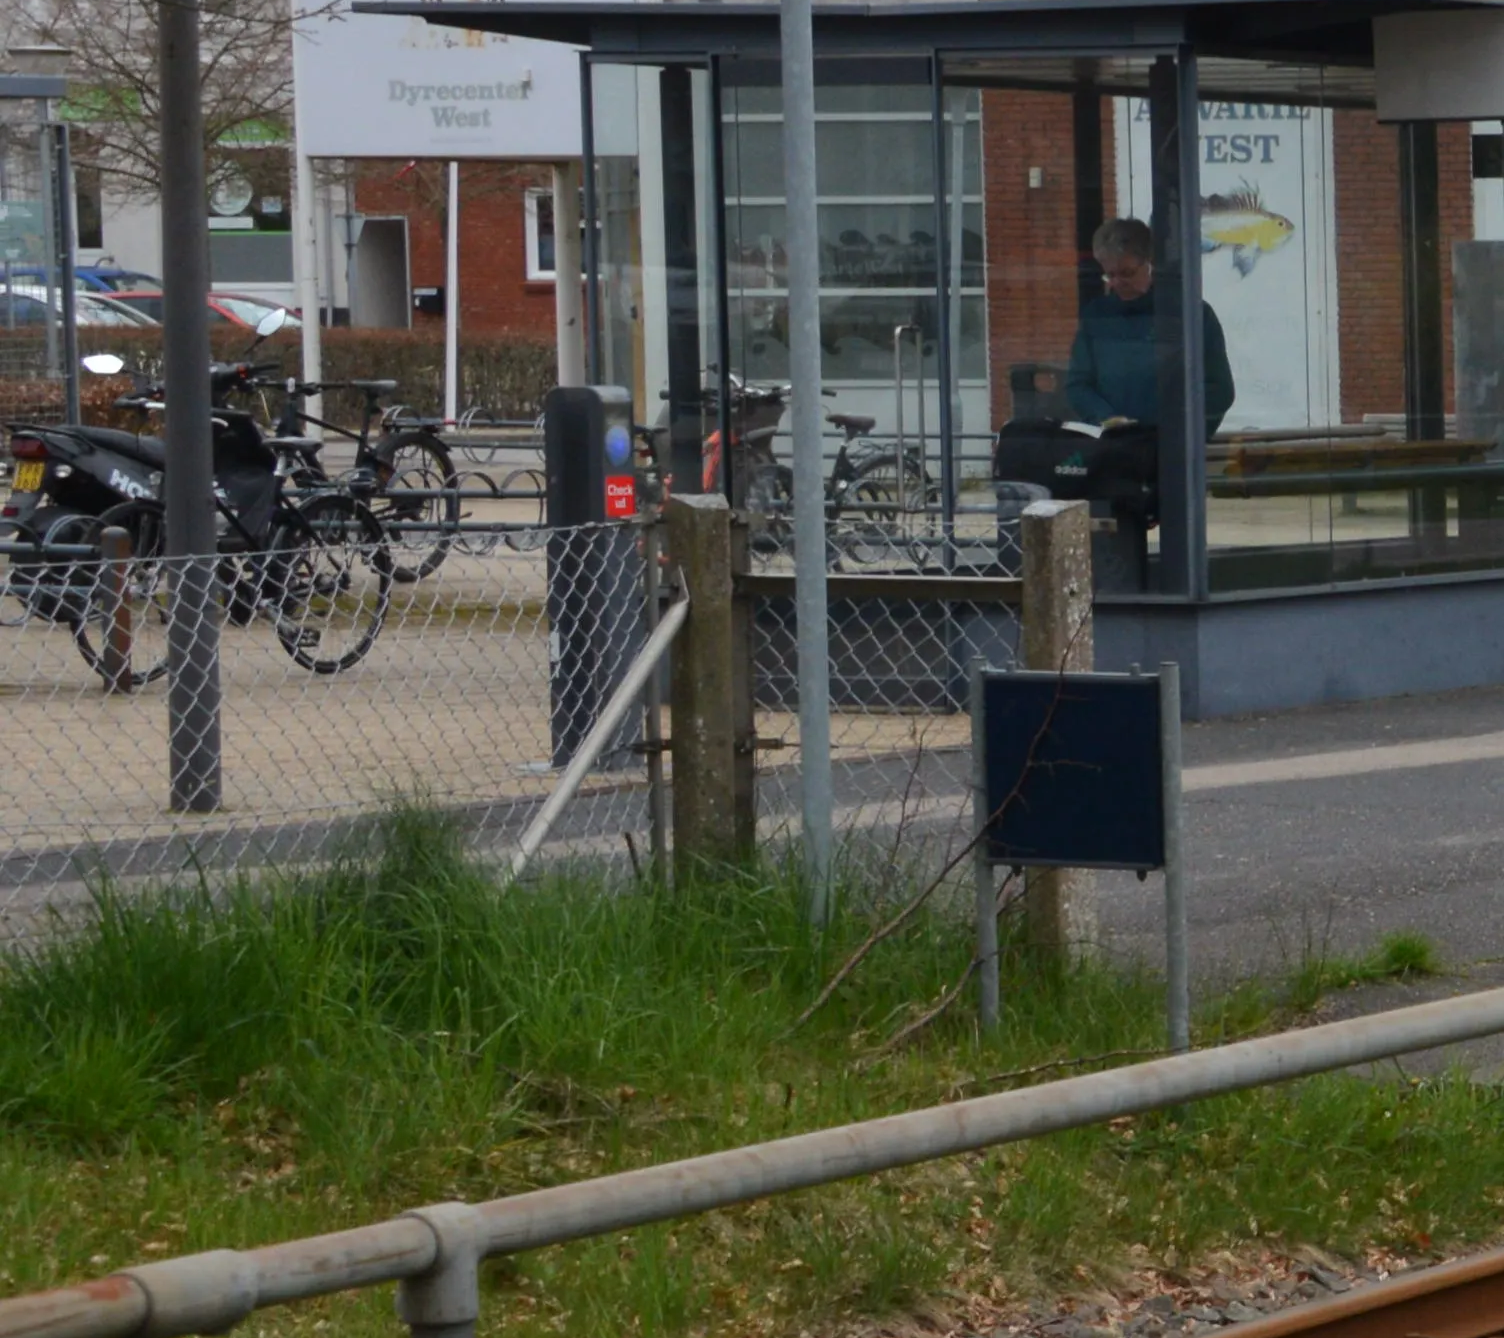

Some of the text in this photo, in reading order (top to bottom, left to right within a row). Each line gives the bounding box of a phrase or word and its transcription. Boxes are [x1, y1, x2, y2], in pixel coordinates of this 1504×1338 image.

[388, 79, 533, 106] Dyrecenter
[430, 106, 492, 128] West
[1199, 134, 1280, 164] EST
